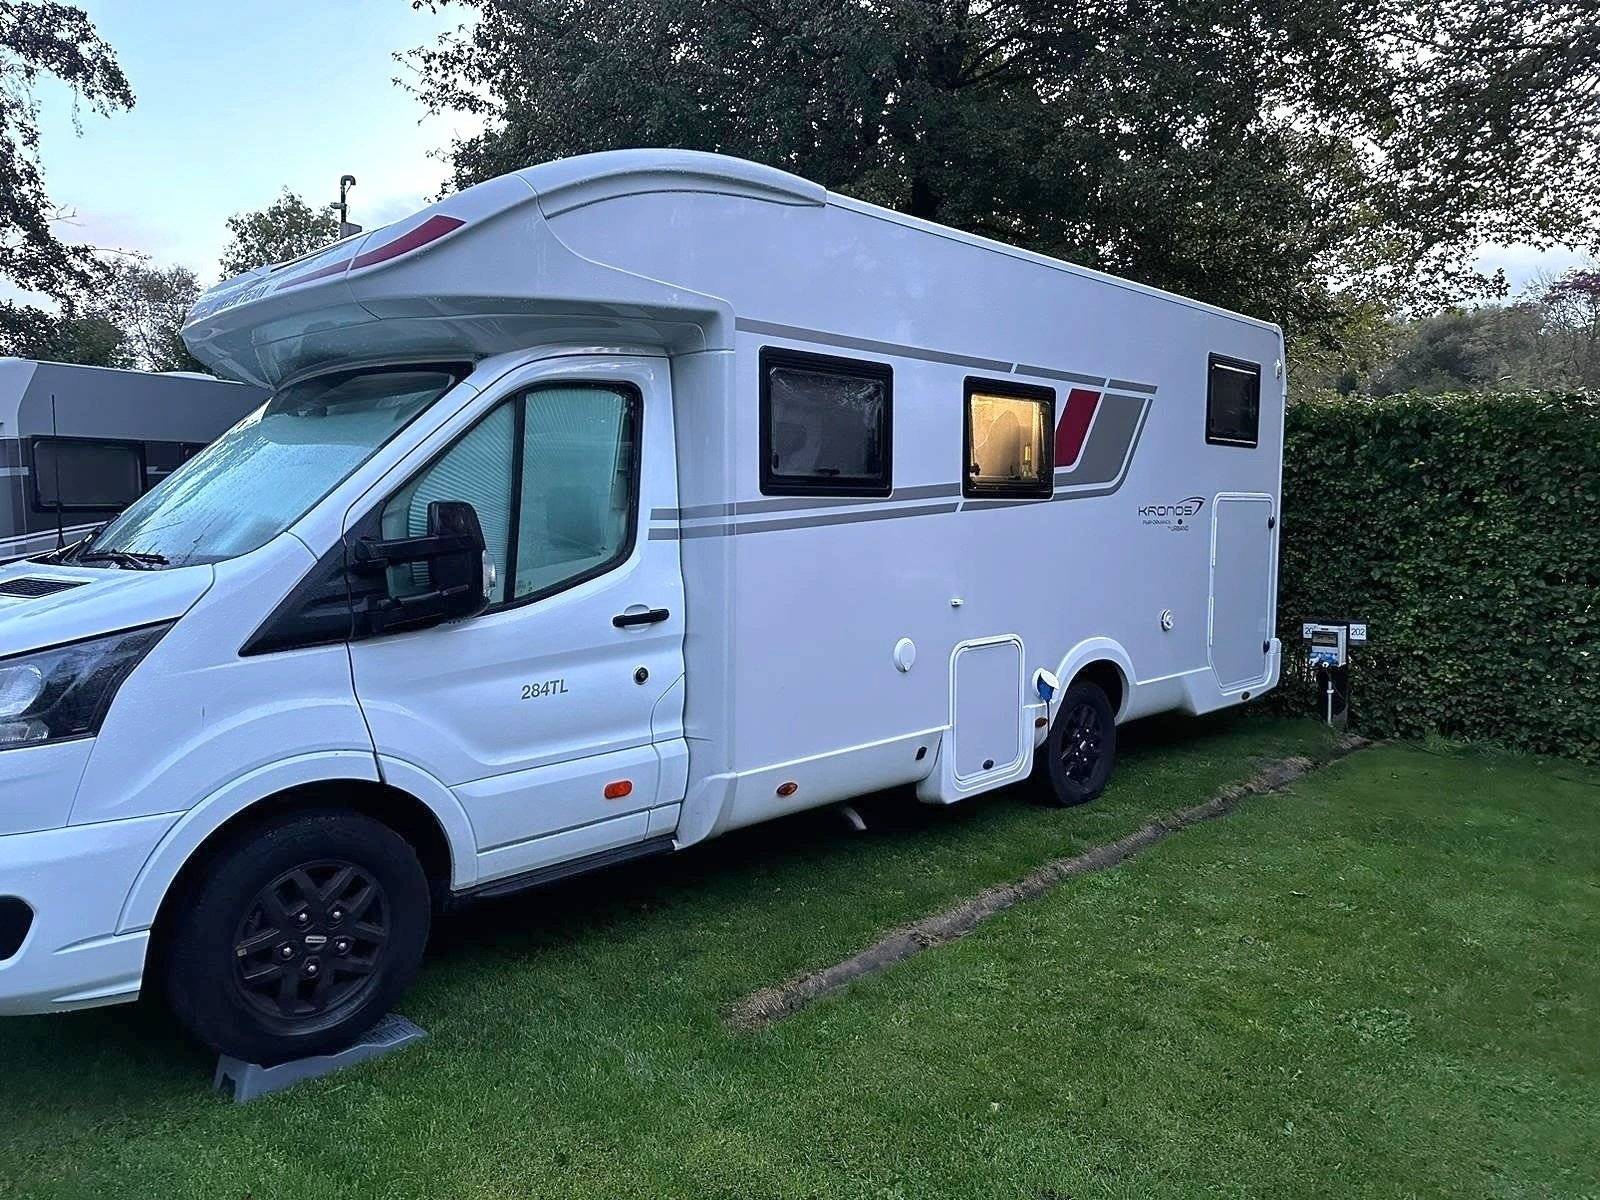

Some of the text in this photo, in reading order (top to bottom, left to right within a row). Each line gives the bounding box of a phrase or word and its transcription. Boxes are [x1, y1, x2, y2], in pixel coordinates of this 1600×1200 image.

[1138, 506, 1193, 517] KRONOS
[1351, 627, 1366, 636] 202
[521, 679, 569, 700] 284TL
